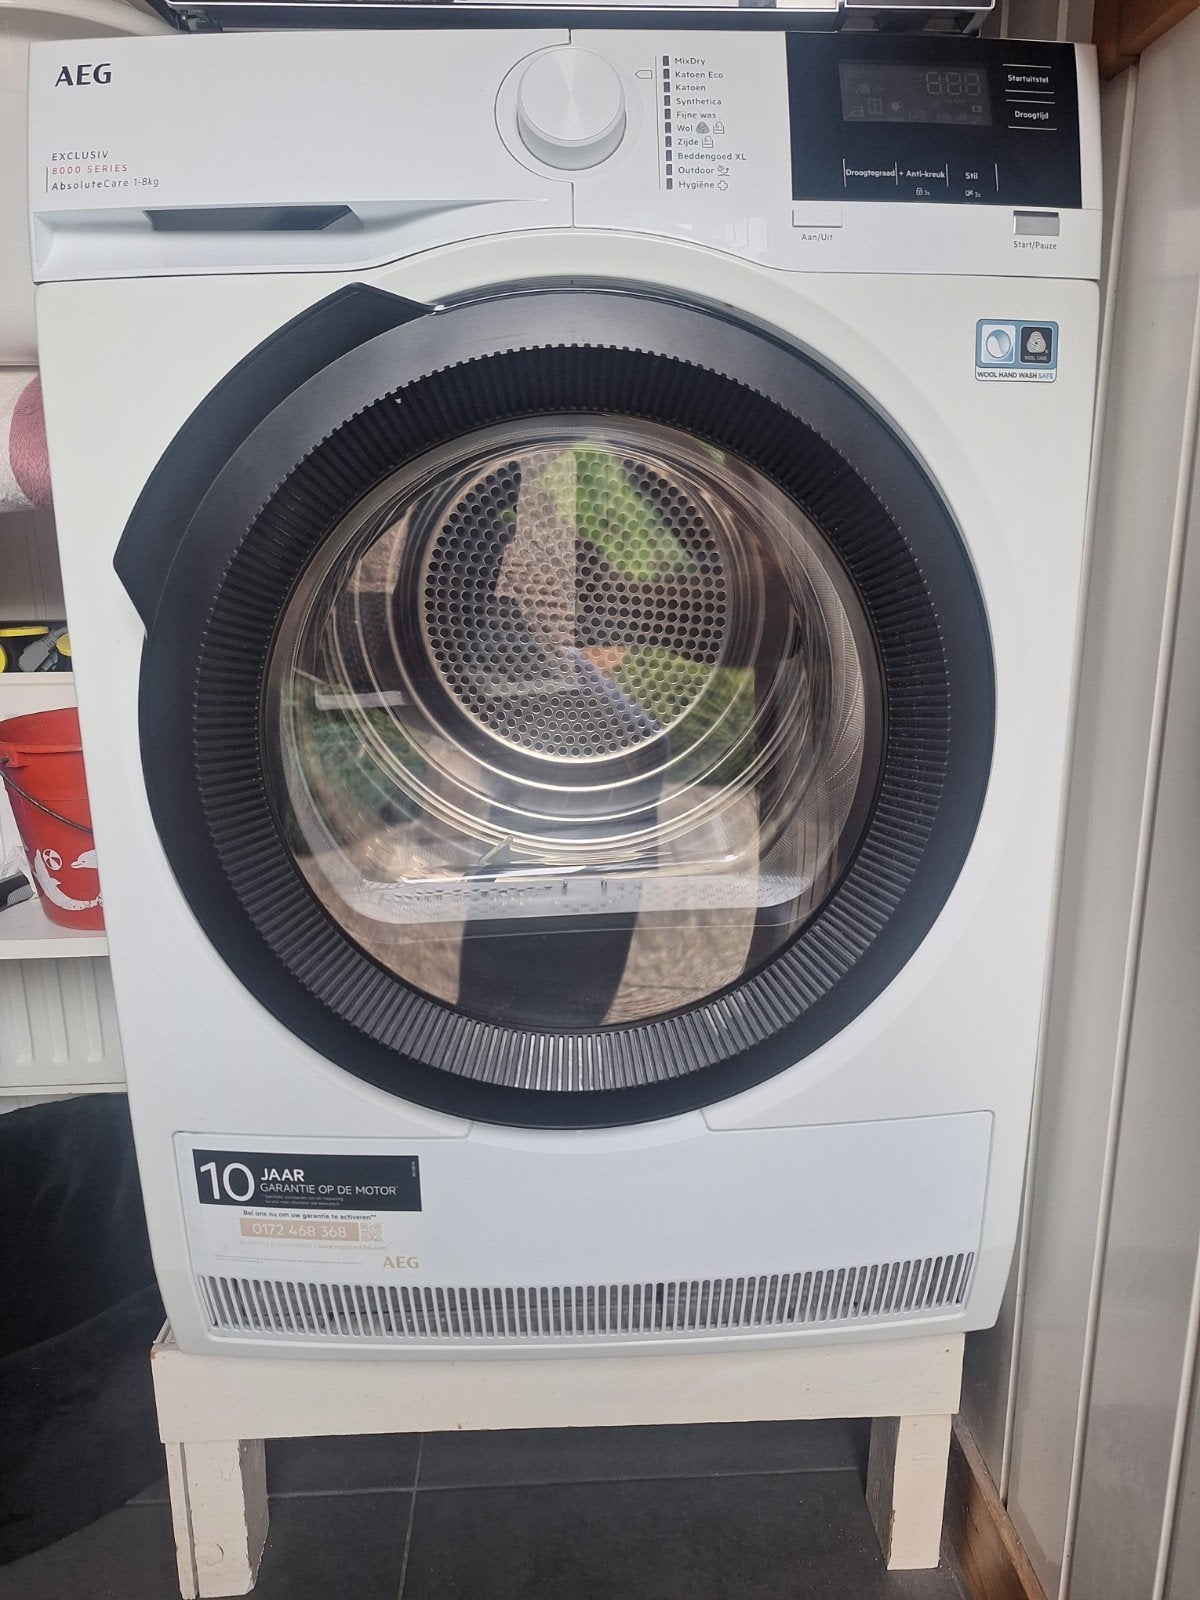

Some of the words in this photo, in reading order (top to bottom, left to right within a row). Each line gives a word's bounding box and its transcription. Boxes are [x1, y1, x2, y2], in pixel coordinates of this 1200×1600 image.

[674, 57, 706, 66] MixDry
[55, 63, 112, 87] AEG
[674, 71, 706, 79] Katoen
[708, 71, 724, 79] Eco
[1007, 73, 1050, 84] Startuitstel
[675, 84, 706, 92] Katoen
[676, 97, 722, 107] Synthetica
[676, 111, 698, 120] Fijne
[1014, 110, 1050, 120] Droogtijd
[676, 124, 694, 132] Wol
[677, 138, 699, 148] Zijde
[51, 150, 110, 161] EXCLUSIV
[677, 152, 733, 162] Beddengoed
[735, 153, 747, 161] XL
[51, 165, 82, 175] 8000
[87, 163, 129, 174] SERIES
[677, 166, 714, 175] Outdoor
[845, 168, 896, 179] Droogtegraad
[905, 169, 946, 179] Anti-kreuk
[965, 171, 979, 180] Stil
[51, 178, 130, 191] AbsoluteCare
[133, 176, 160, 188] 1-8kg
[678, 180, 715, 190] Hygiëne
[801, 233, 834, 242] Aan/Uit
[1013, 240, 1058, 251] Start/Pauze
[977, 371, 997, 379] WOOL
[998, 371, 1018, 379] HAND
[260, 1168, 305, 1183] JAAR
[200, 1161, 256, 1202] 10
[259, 1182, 316, 1195] GARANTIE
[318, 1184, 335, 1195] OP
[337, 1185, 353, 1195] DE
[252, 1222, 286, 1237] 0172
[288, 1224, 317, 1238] 468
[320, 1225, 348, 1239] 368
[382, 1255, 420, 1270] AEG
